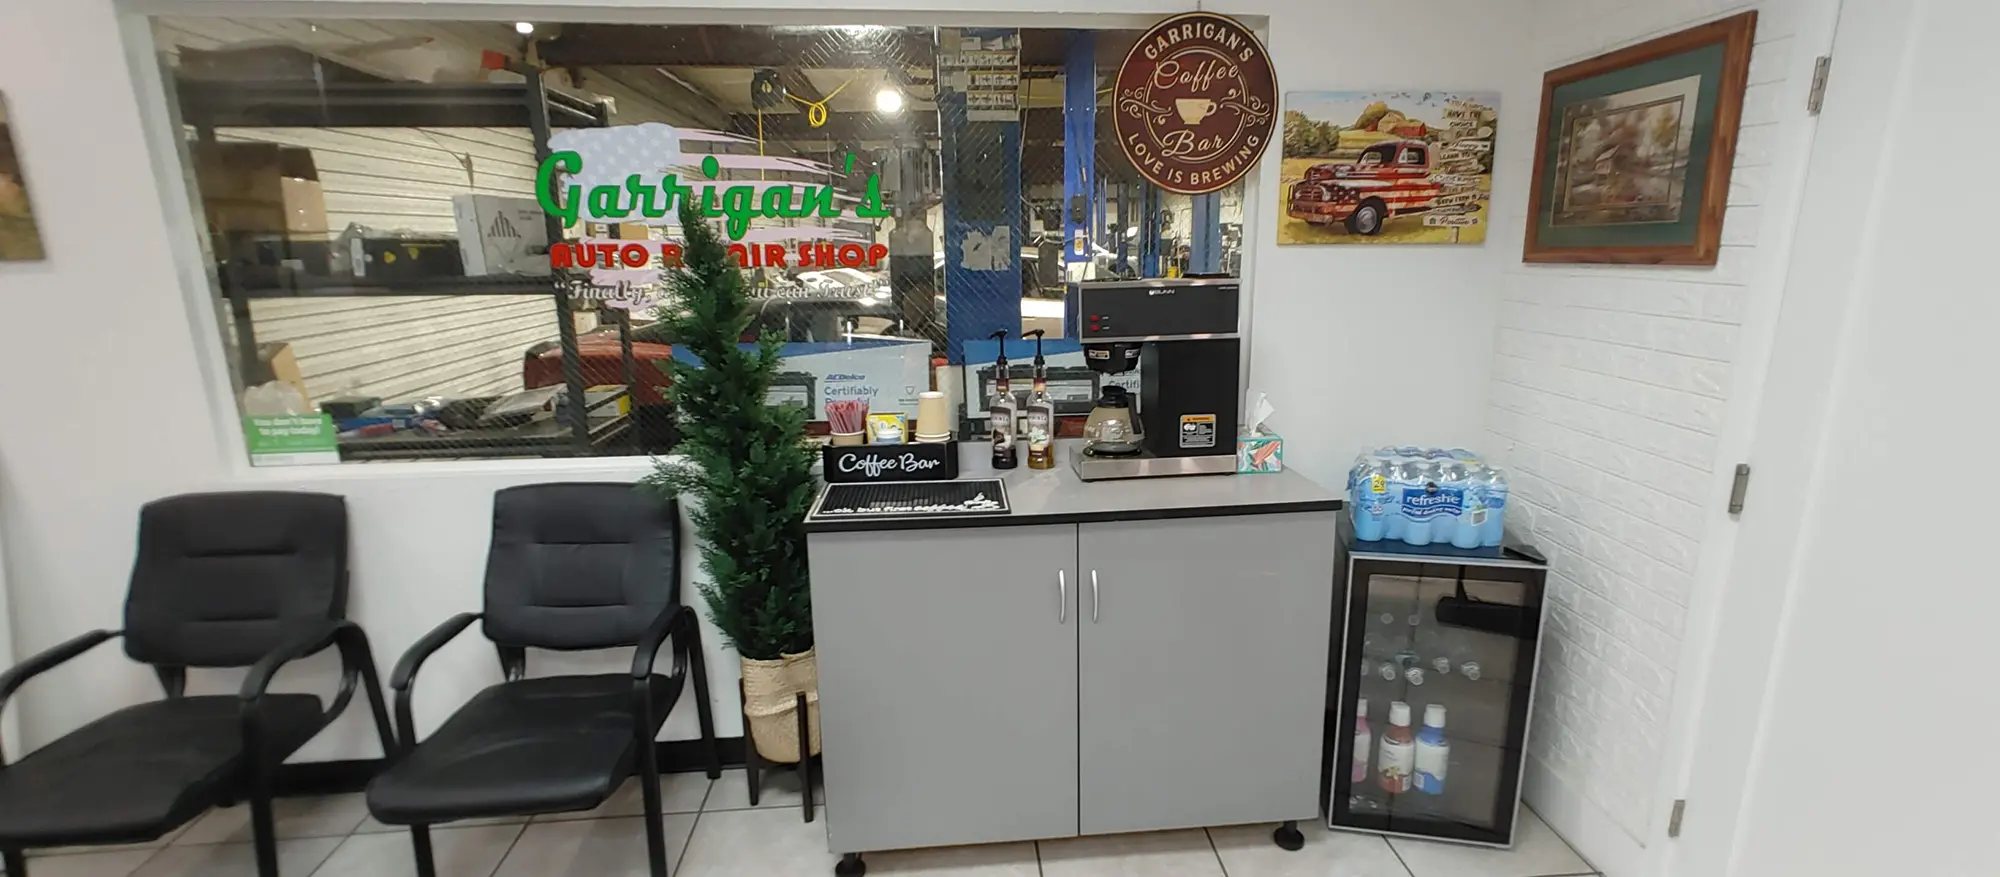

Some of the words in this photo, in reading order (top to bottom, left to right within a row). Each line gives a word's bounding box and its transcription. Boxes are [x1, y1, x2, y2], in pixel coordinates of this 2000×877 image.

[1144, 22, 1254, 63] GARRIGAN'S
[1154, 59, 1240, 93] Coffee
[1161, 129, 1225, 157] Bar
[1128, 132, 1165, 176] LOVE
[1167, 168, 1183, 184] IS
[1190, 134, 1260, 186] BREWING
[535, 150, 891, 241] Garrigan's
[550, 243, 649, 269] AUTO
[662, 243, 788, 269] RAIR
[798, 243, 889, 269] SHOP
[824, 385, 879, 398] Certifiably
[838, 452, 898, 477] Coffee
[899, 452, 940, 470] Bar
